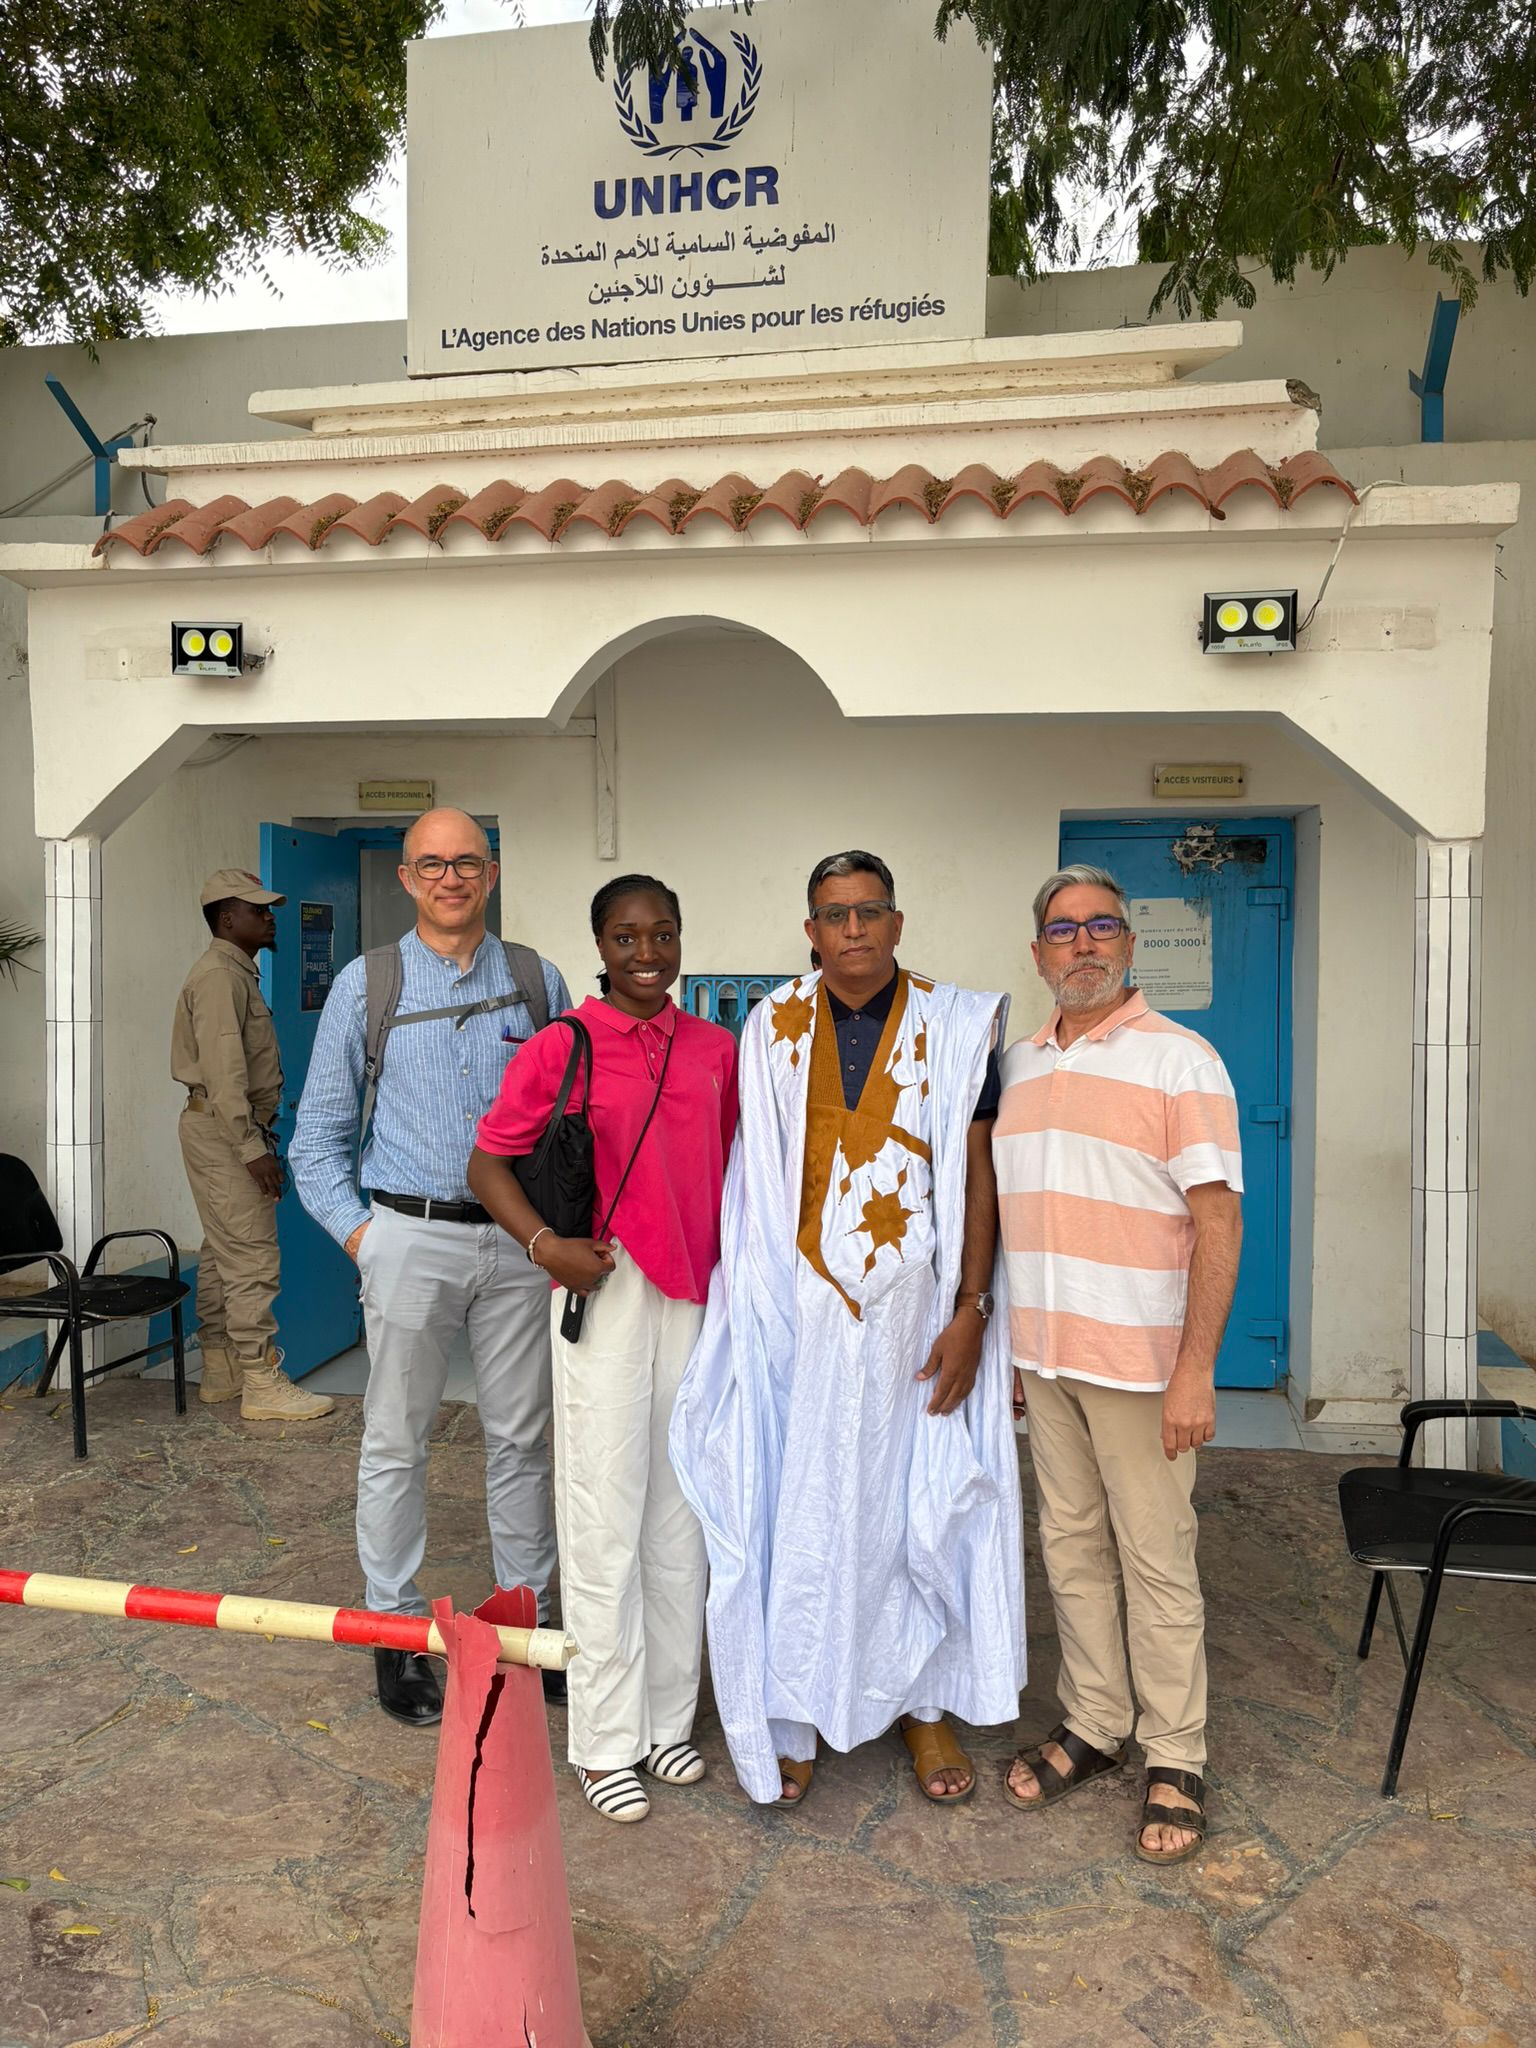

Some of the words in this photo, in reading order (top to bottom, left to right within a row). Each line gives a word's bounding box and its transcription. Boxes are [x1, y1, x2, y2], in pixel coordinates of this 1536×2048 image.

[594, 165, 779, 220] UNHCR
[613, 233, 660, 268] للأمم
[666, 230, 736, 261] السامية
[743, 222, 836, 255] المفوضية
[541, 242, 607, 266] المتحدة
[441, 327, 540, 352] L’Agence
[546, 321, 586, 342] des
[592, 316, 676, 339] Nations
[682, 310, 746, 334] Unies
[752, 307, 806, 333] pour
[811, 303, 844, 325] les
[849, 293, 946, 323] réfugiés
[1192, 775, 1234, 784] VISITEURS
[387, 791, 425, 799] PERSONNEL
[1143, 939, 1170, 948] 8000
[1174, 938, 1201, 947] 3000
[306, 962, 328, 972] FRAUDE
